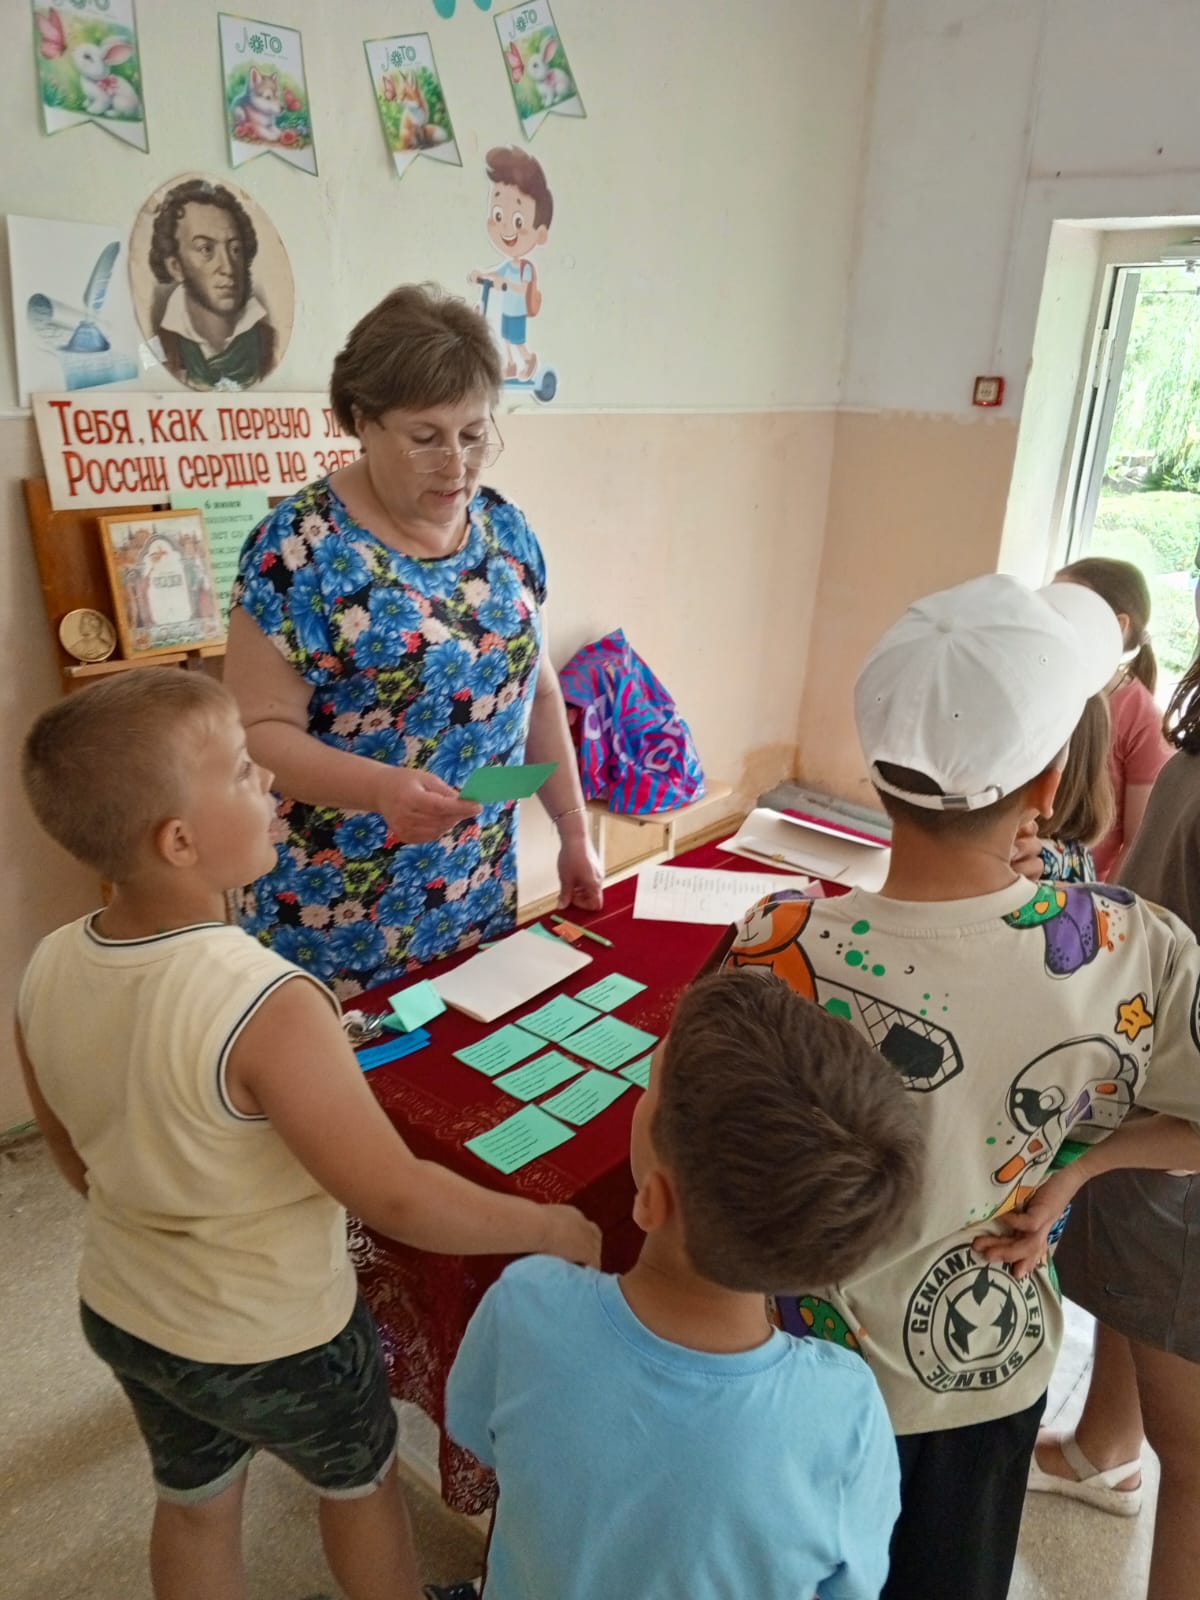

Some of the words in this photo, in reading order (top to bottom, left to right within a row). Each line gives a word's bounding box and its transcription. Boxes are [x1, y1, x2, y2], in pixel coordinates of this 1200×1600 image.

[148, 408, 208, 443] как
[217, 407, 310, 441] первую
[62, 451, 170, 497] России
[178, 452, 270, 490] сердце
[276, 451, 307, 484] не
